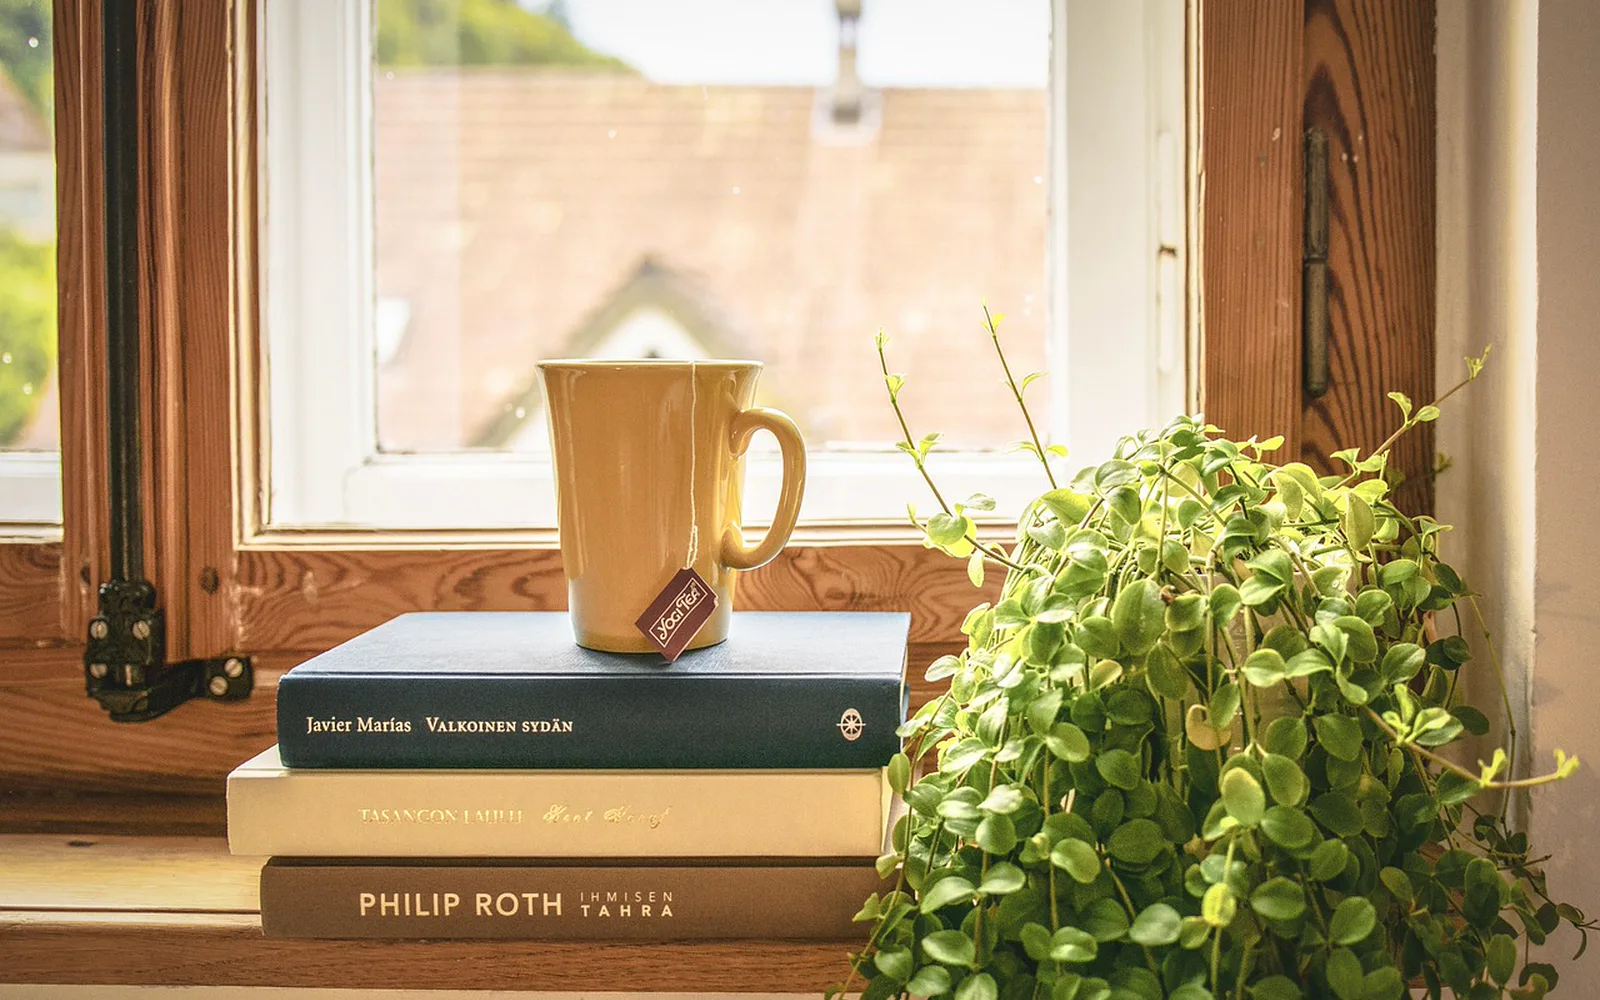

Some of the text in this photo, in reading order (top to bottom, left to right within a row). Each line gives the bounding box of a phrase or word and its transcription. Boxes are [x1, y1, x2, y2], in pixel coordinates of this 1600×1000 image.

[657, 608, 685, 640] YOGI
[306, 716, 574, 735] Javier Marías VALKOINEN SYDÄN
[359, 892, 563, 917] PHILIP ROTH
[580, 891, 674, 902] IHMISEN
[580, 904, 674, 918] TAHRA
